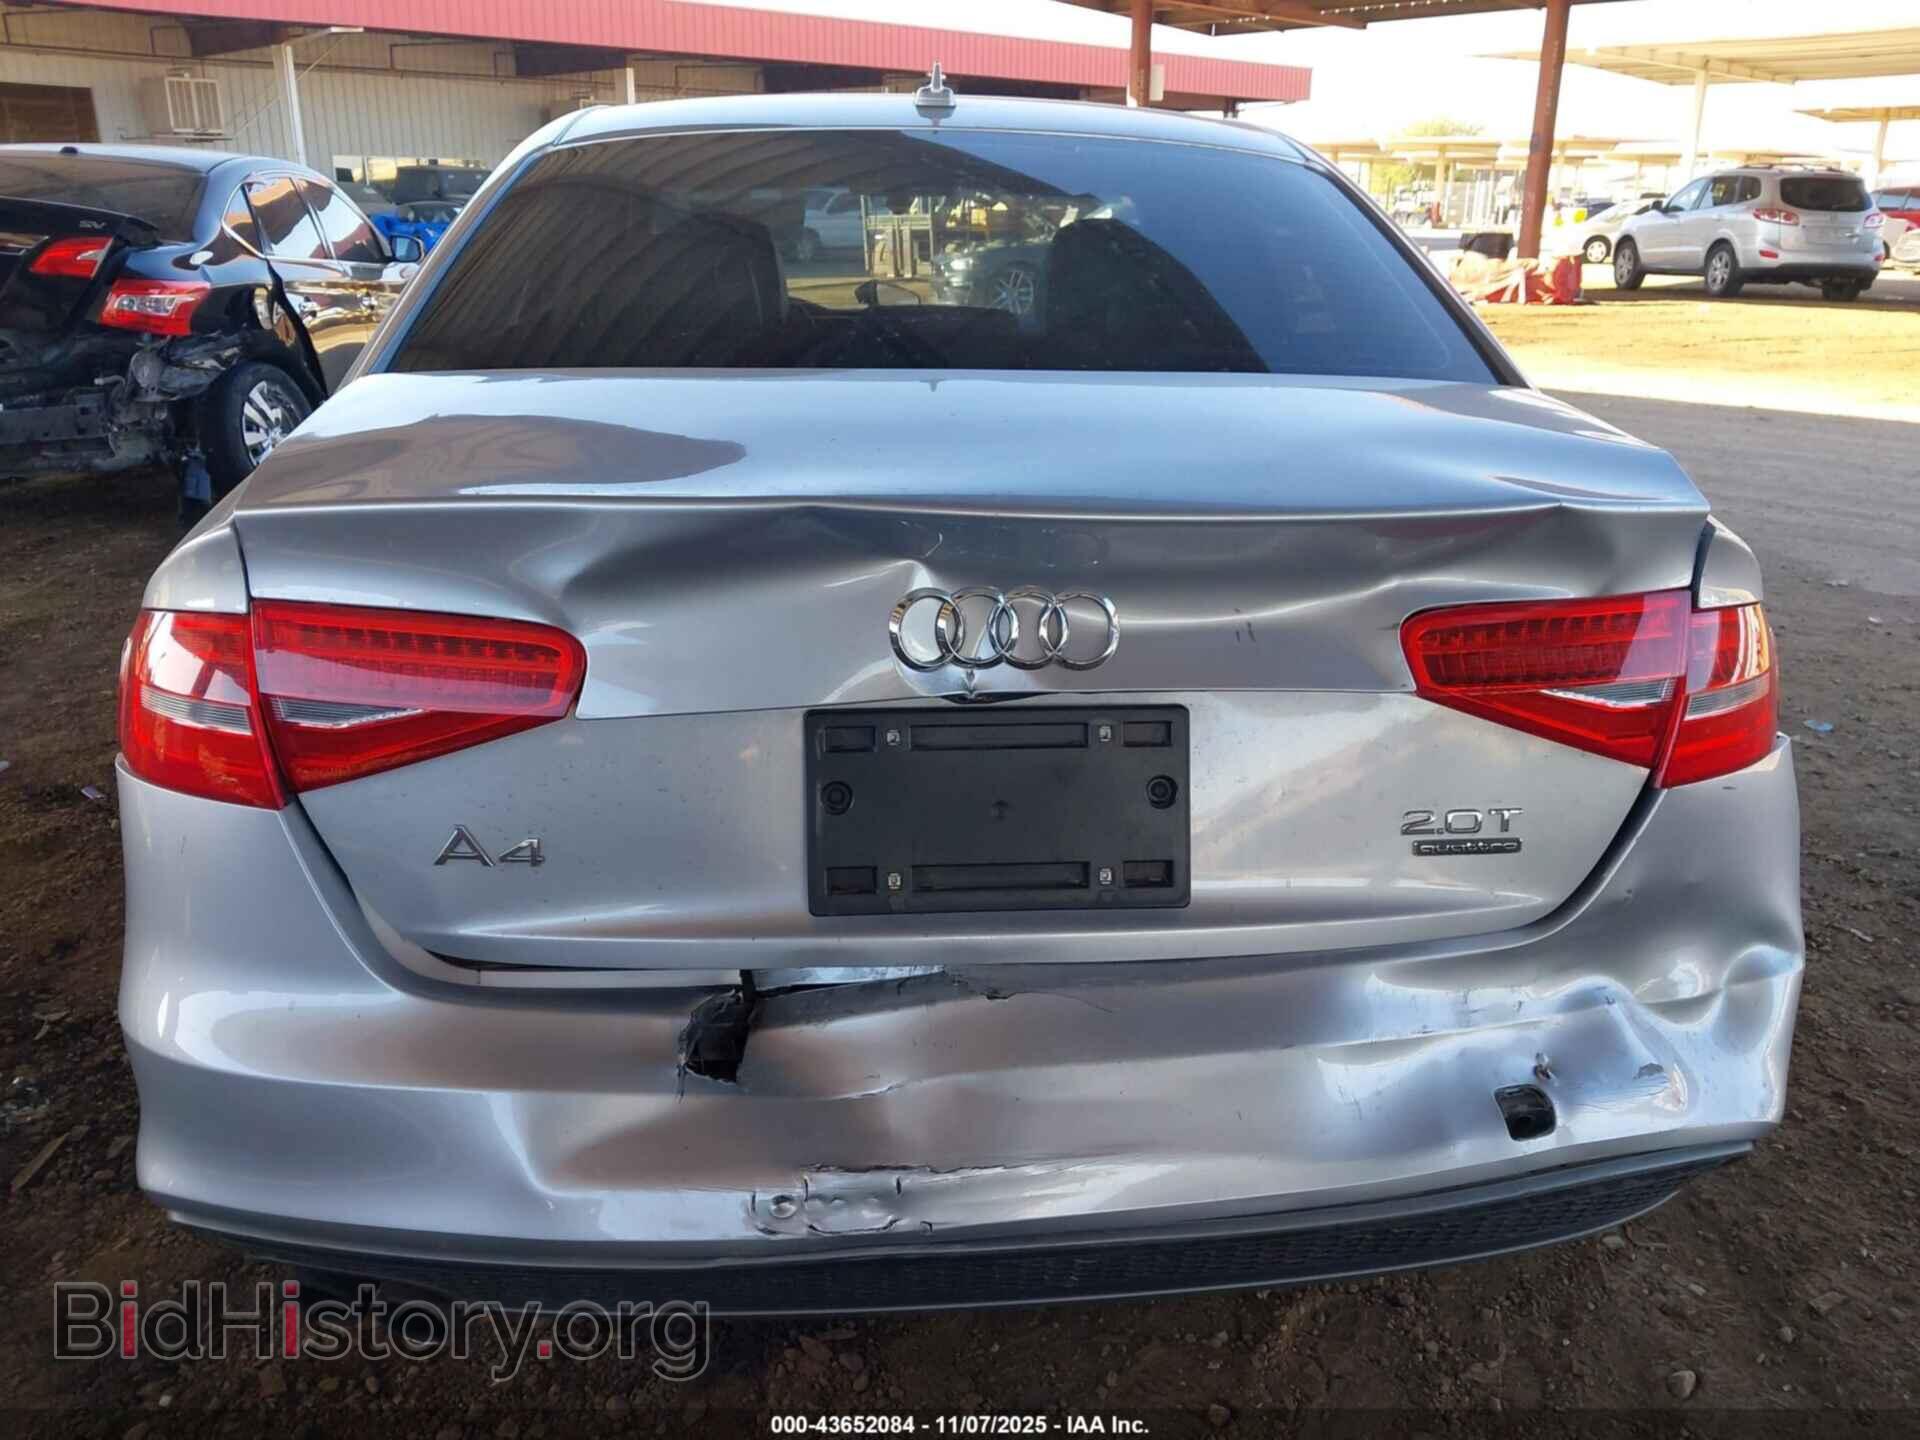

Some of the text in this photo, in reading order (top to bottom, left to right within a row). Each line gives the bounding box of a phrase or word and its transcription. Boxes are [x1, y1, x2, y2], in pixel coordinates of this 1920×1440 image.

[1400, 808, 1523, 836] 2.0T
[433, 824, 545, 867] A4
[1418, 841, 1519, 854] quattro
